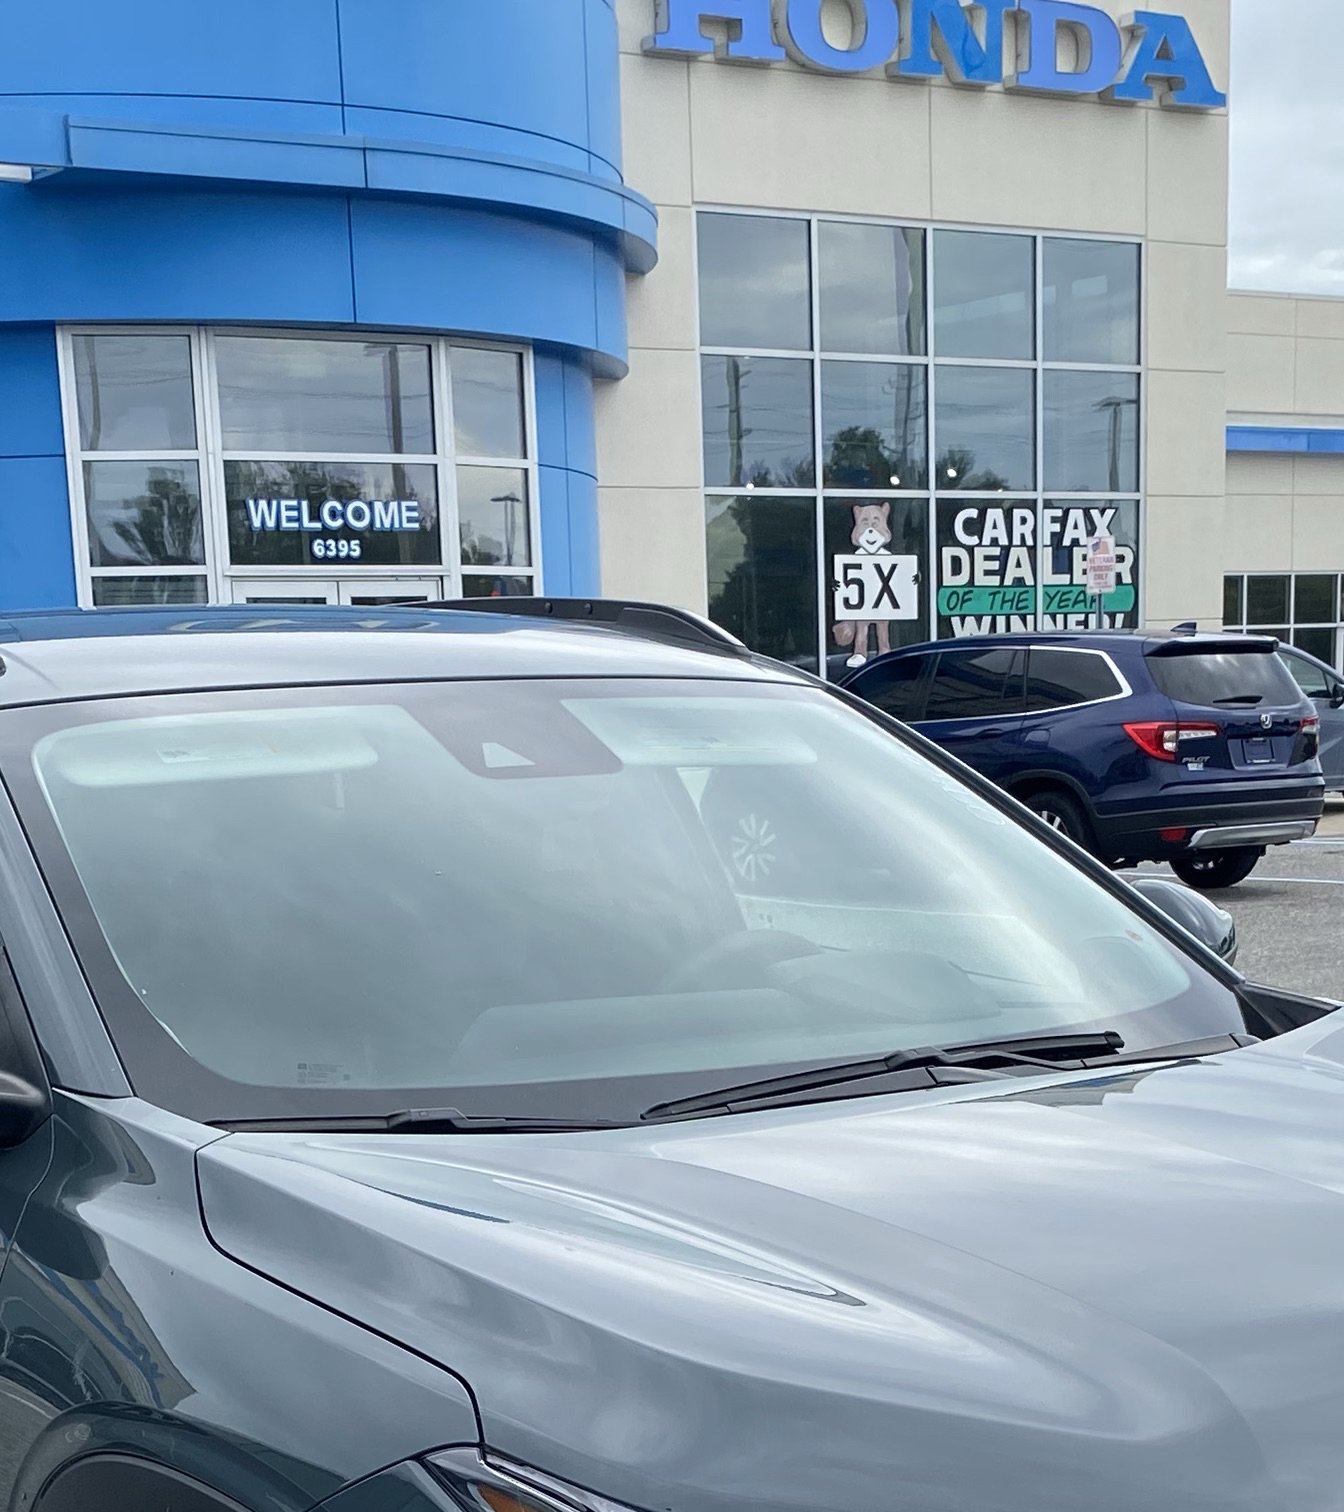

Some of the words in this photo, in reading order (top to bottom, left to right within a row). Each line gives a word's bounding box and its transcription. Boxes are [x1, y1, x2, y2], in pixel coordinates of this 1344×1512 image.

[643, 0, 1227, 108] HONDA
[247, 499, 420, 529] WELCOME
[953, 507, 1116, 547] CARFAX
[283, 538, 361, 559] 6395
[941, 546, 1134, 587] DEALER
[842, 563, 901, 610] 5X
[946, 589, 974, 611] OF
[988, 588, 1031, 611] THE
